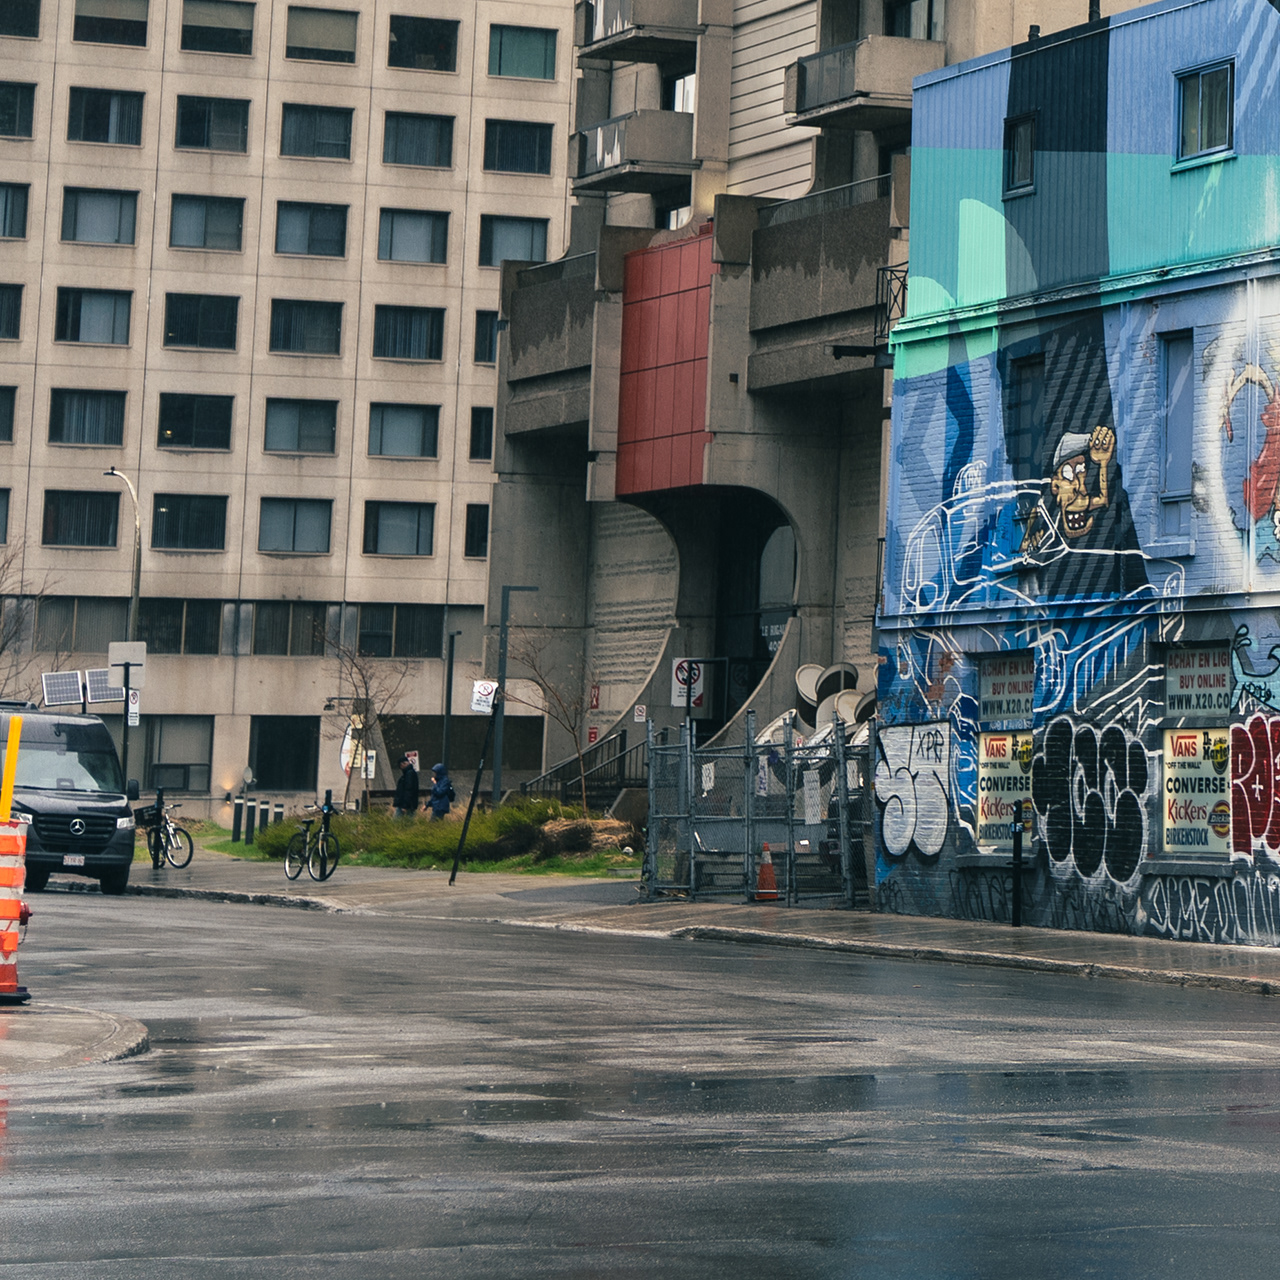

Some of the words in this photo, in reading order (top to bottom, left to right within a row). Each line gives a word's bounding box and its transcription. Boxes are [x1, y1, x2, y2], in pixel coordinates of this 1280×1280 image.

[1168, 653, 1197, 668] ACHAT
[1199, 653, 1210, 668] EN
[982, 663, 1005, 677] ACHAT
[1008, 662, 1020, 676] EN
[1021, 661, 1034, 675] LIG
[992, 683, 1005, 695] BUY
[1008, 681, 1033, 694] ONLINE
[1180, 674, 1195, 689] BUY
[1197, 673, 1226, 688] ONLINE
[1168, 693, 1229, 709] WWW.X20.CO
[984, 738, 1007, 758] VANS
[1011, 747, 1033, 761] Marte
[1170, 735, 1197, 757] VANS
[1203, 744, 1229, 760] Marte
[980, 776, 1031, 792] CONVERSE
[1167, 777, 1225, 793] CONVERSE
[1166, 828, 1208, 846] BIRKENSTOCK
